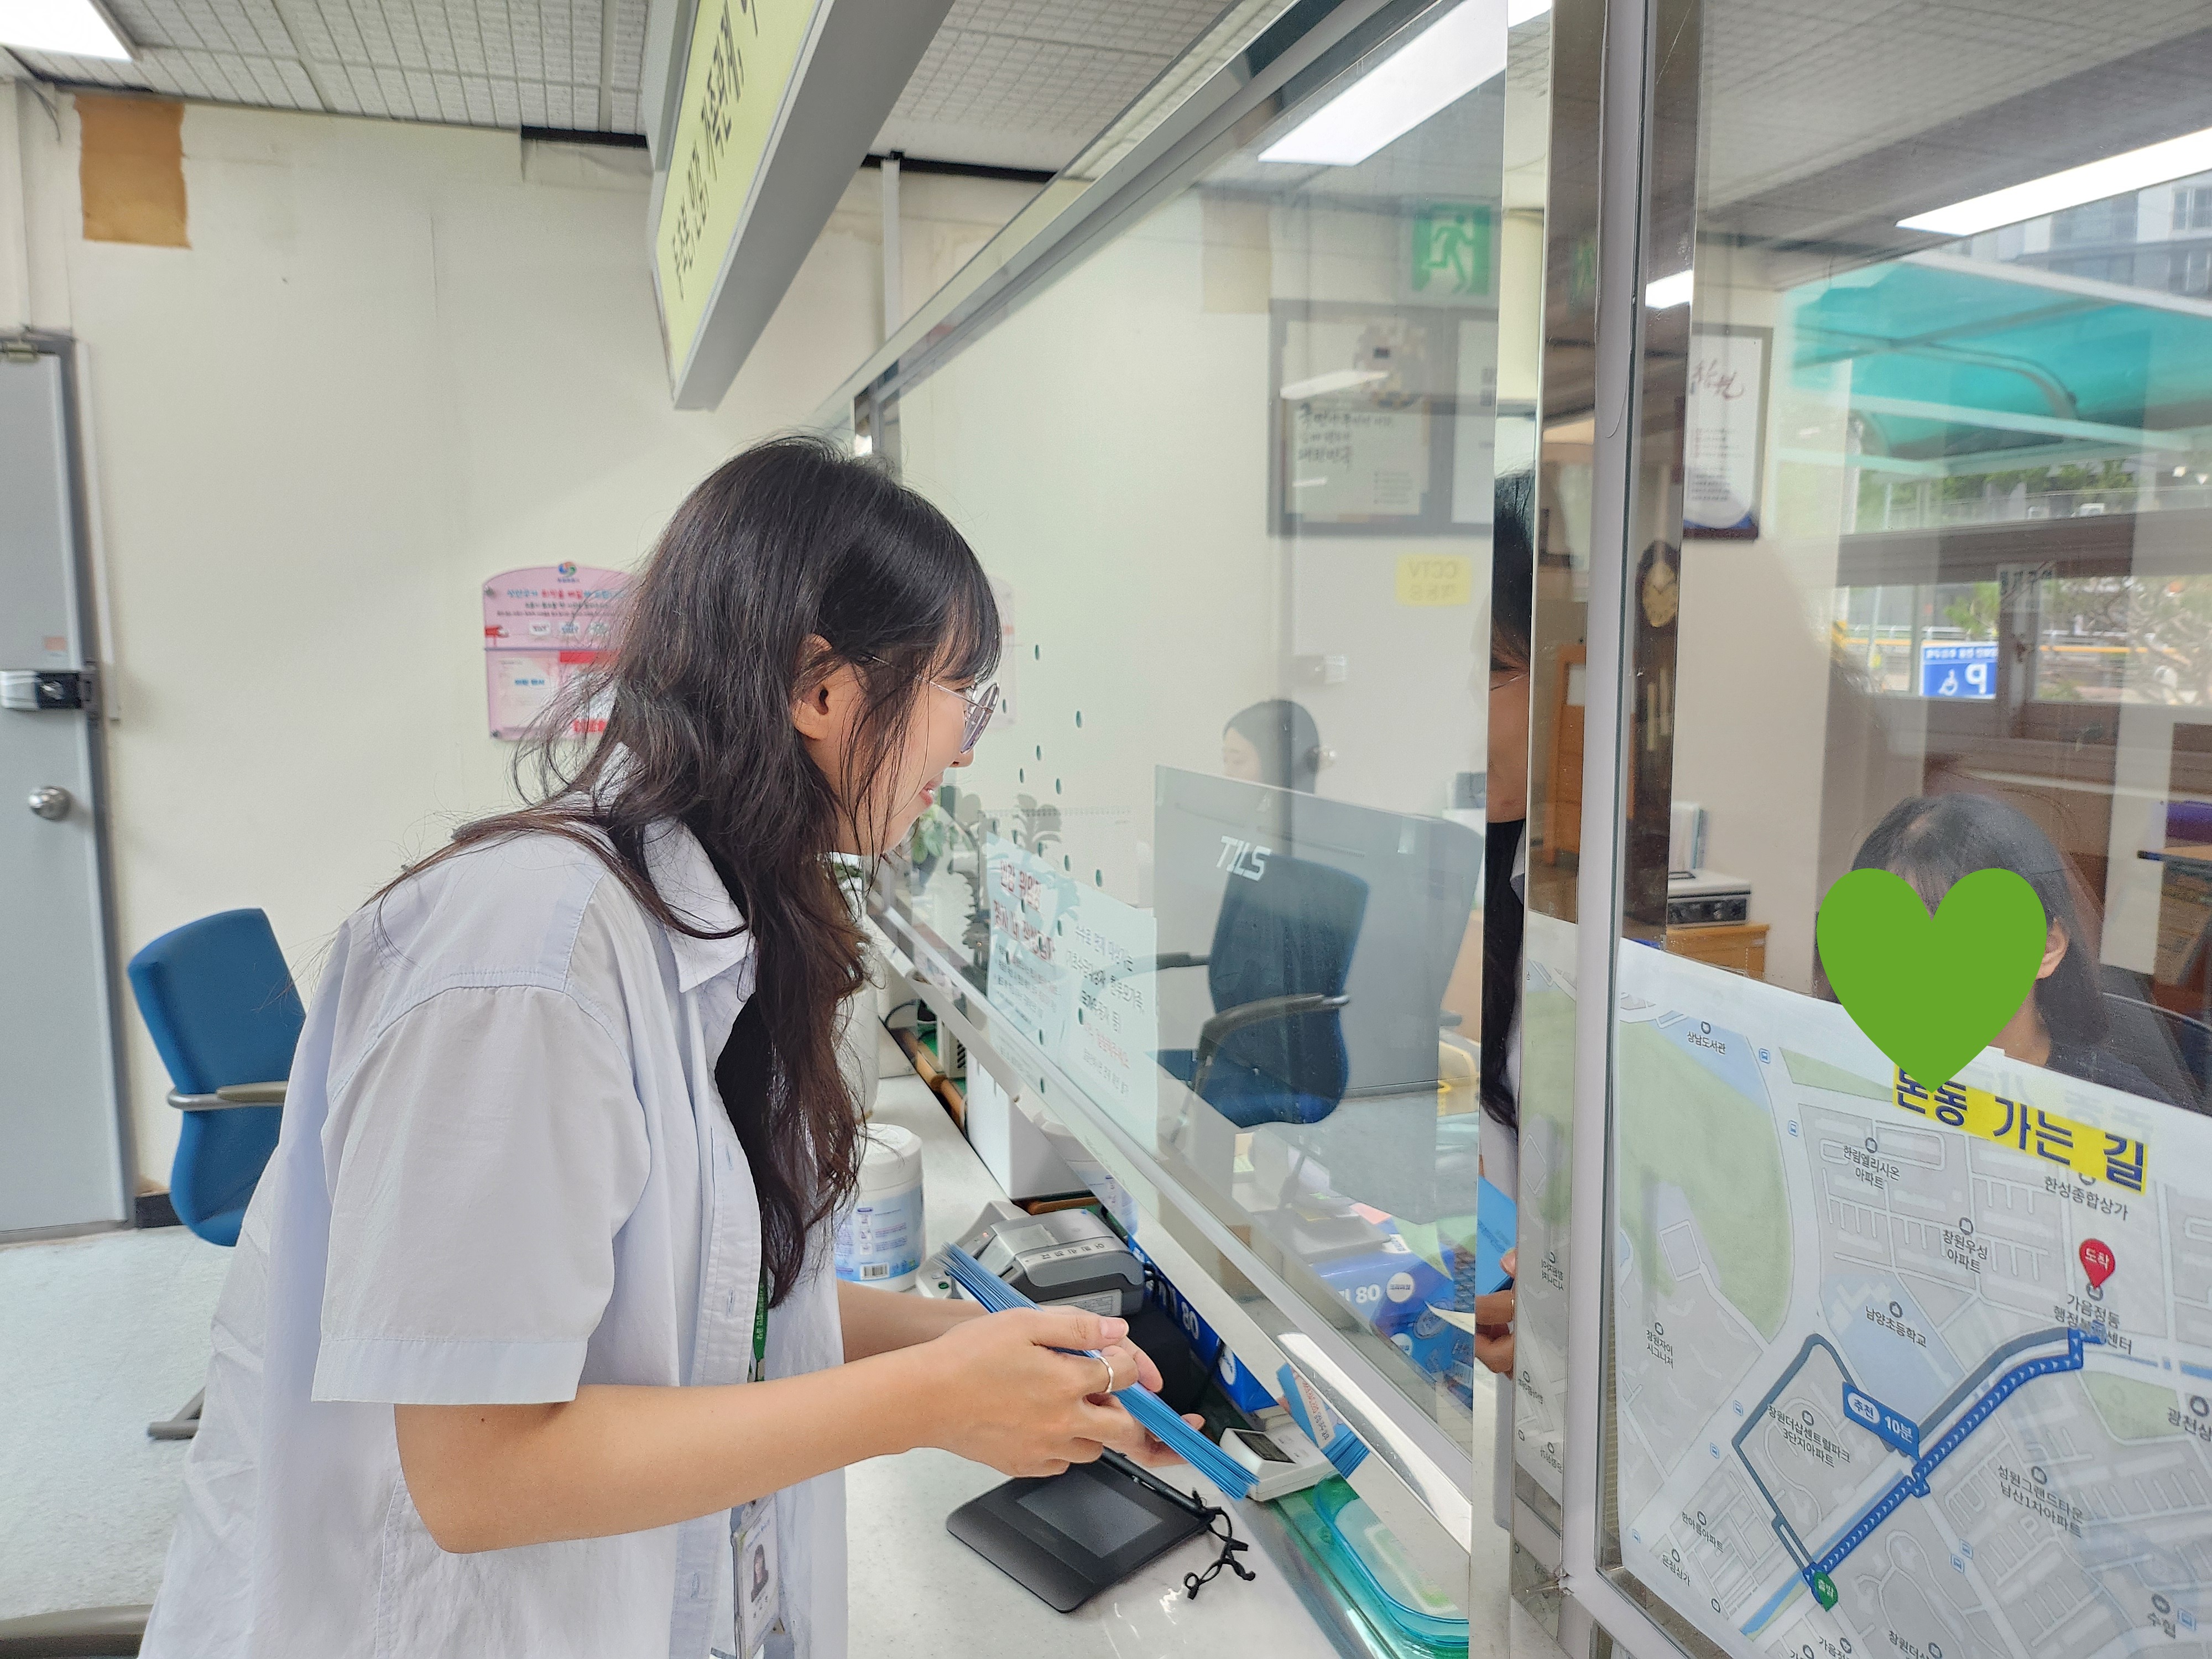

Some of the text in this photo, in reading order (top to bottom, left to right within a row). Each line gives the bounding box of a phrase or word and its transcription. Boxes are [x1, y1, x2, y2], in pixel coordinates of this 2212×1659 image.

[1687, 1031, 1726, 1055] 상남도서관
[1992, 1095, 2074, 1166] 가는
[2103, 1133, 2144, 1192] 길
[1843, 1145, 1900, 1181] 한림엘리시온
[1855, 1167, 1884, 1190] 아파트
[2044, 1176, 2128, 1220] 한성종합상가
[1942, 1229, 1988, 1260] 창원우성
[1947, 1249, 1981, 1274] 아파트
[2084, 1248, 2110, 1271] 도착
[1355, 1284, 1380, 1304] 80
[2067, 1293, 2120, 1329] 가음정동
[1646, 1329, 1673, 1357] 창원자이
[1865, 1305, 1926, 1348] 남양초등학교
[2054, 1305, 2132, 1355] 행정센터
[1647, 1343, 1673, 1369] 시그니처
[1854, 1398, 1913, 1444] 추천 10분
[1782, 1427, 1835, 1468] 3단지아파트
[2000, 1480, 2083, 1539] 남산1차아파트
[1682, 1511, 1724, 1553] 한아름아파트
